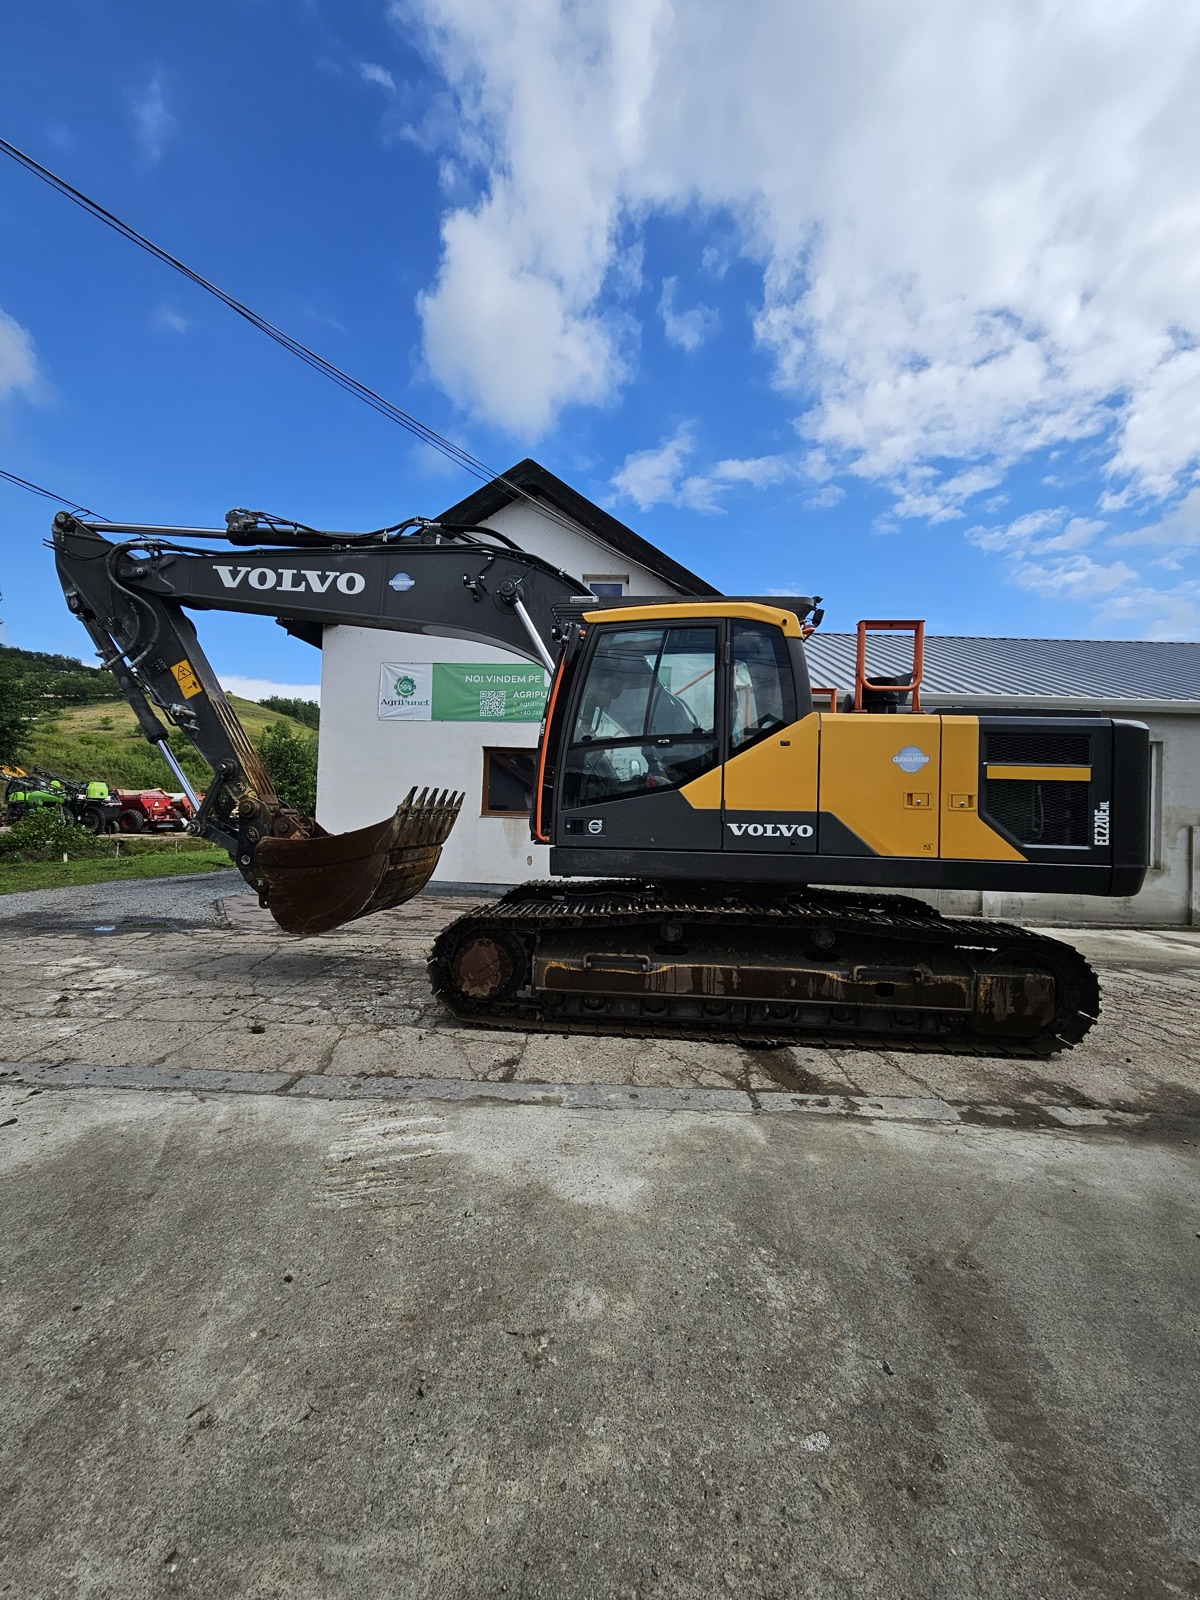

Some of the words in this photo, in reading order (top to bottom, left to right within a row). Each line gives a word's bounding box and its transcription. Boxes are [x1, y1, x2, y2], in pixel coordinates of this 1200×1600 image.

[212, 565, 366, 595] VOLVO
[465, 674, 484, 683] NOI
[486, 674, 526, 683] VINDEM
[528, 675, 541, 683] PE
[380, 698, 430, 707] AgriPunct
[892, 755, 930, 763] GAVARINI
[726, 823, 814, 838] VOLVO
